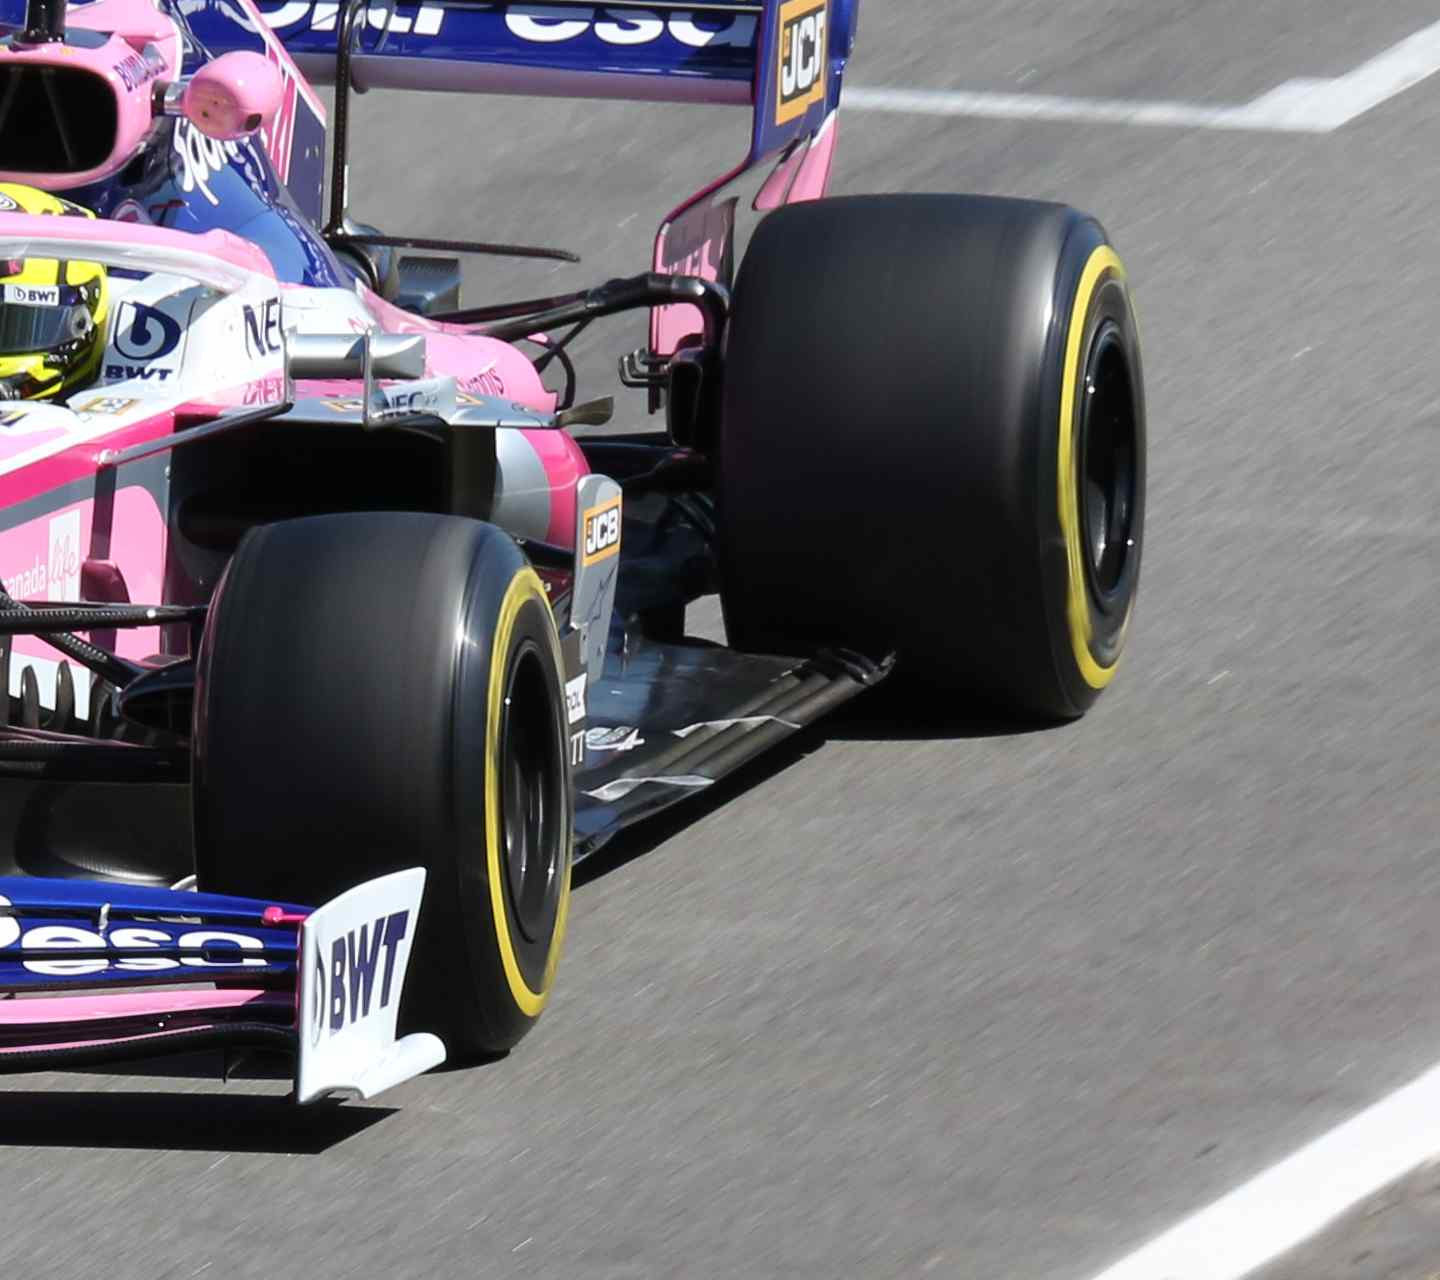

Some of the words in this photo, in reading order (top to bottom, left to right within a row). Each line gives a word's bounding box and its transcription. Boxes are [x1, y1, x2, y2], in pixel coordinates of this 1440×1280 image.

[27, 289, 57, 303] BWT
[104, 364, 173, 381] BWT
[586, 508, 619, 555] JCB
[330, 910, 411, 1030] BWT
